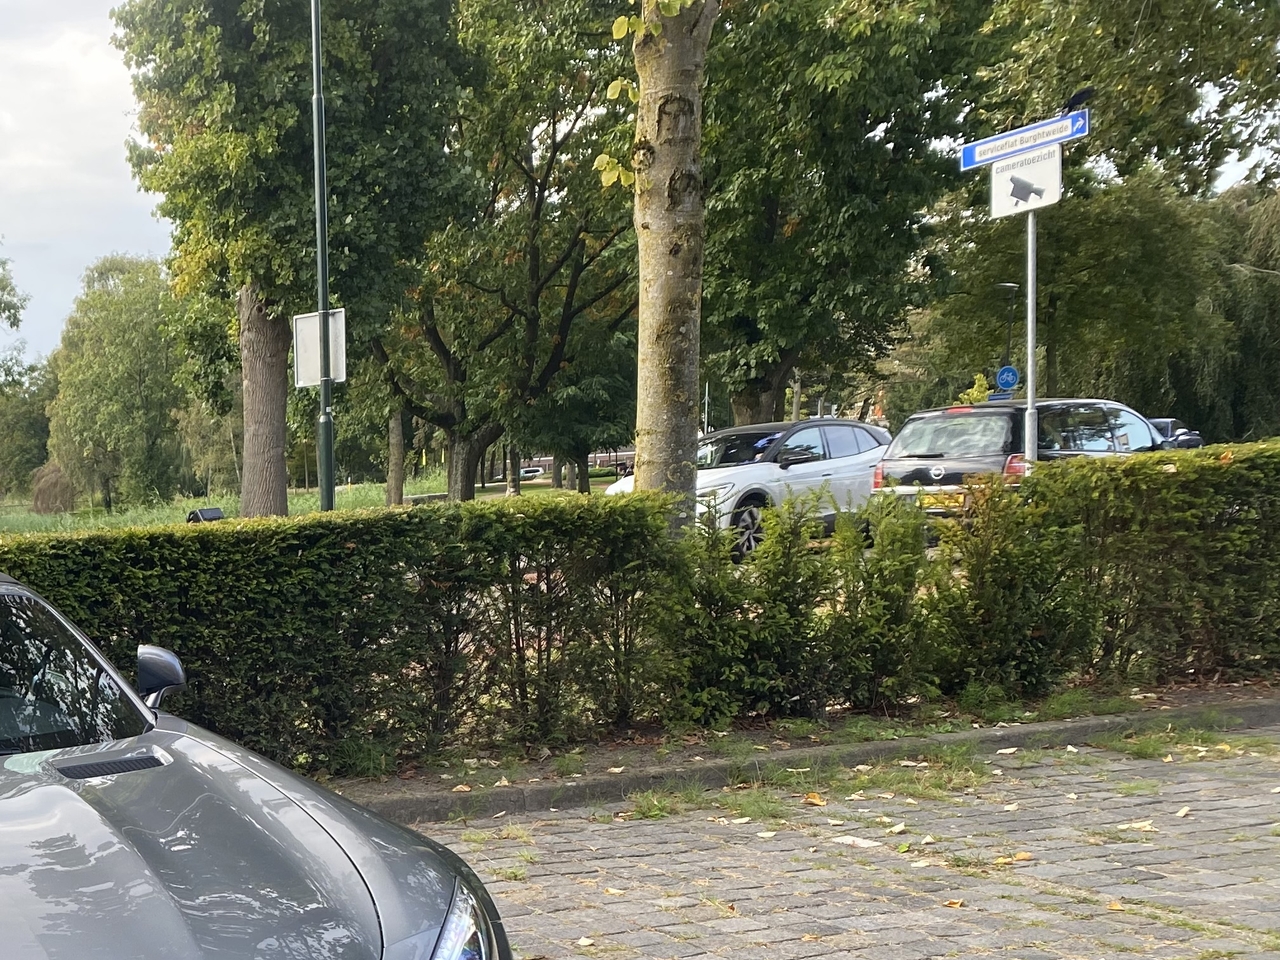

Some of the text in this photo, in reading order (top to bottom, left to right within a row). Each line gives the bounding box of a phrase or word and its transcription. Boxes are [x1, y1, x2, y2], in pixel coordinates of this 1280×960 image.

[978, 123, 1069, 157] serviceflat Burghtweide
[995, 149, 1056, 174] cameratoezicht
